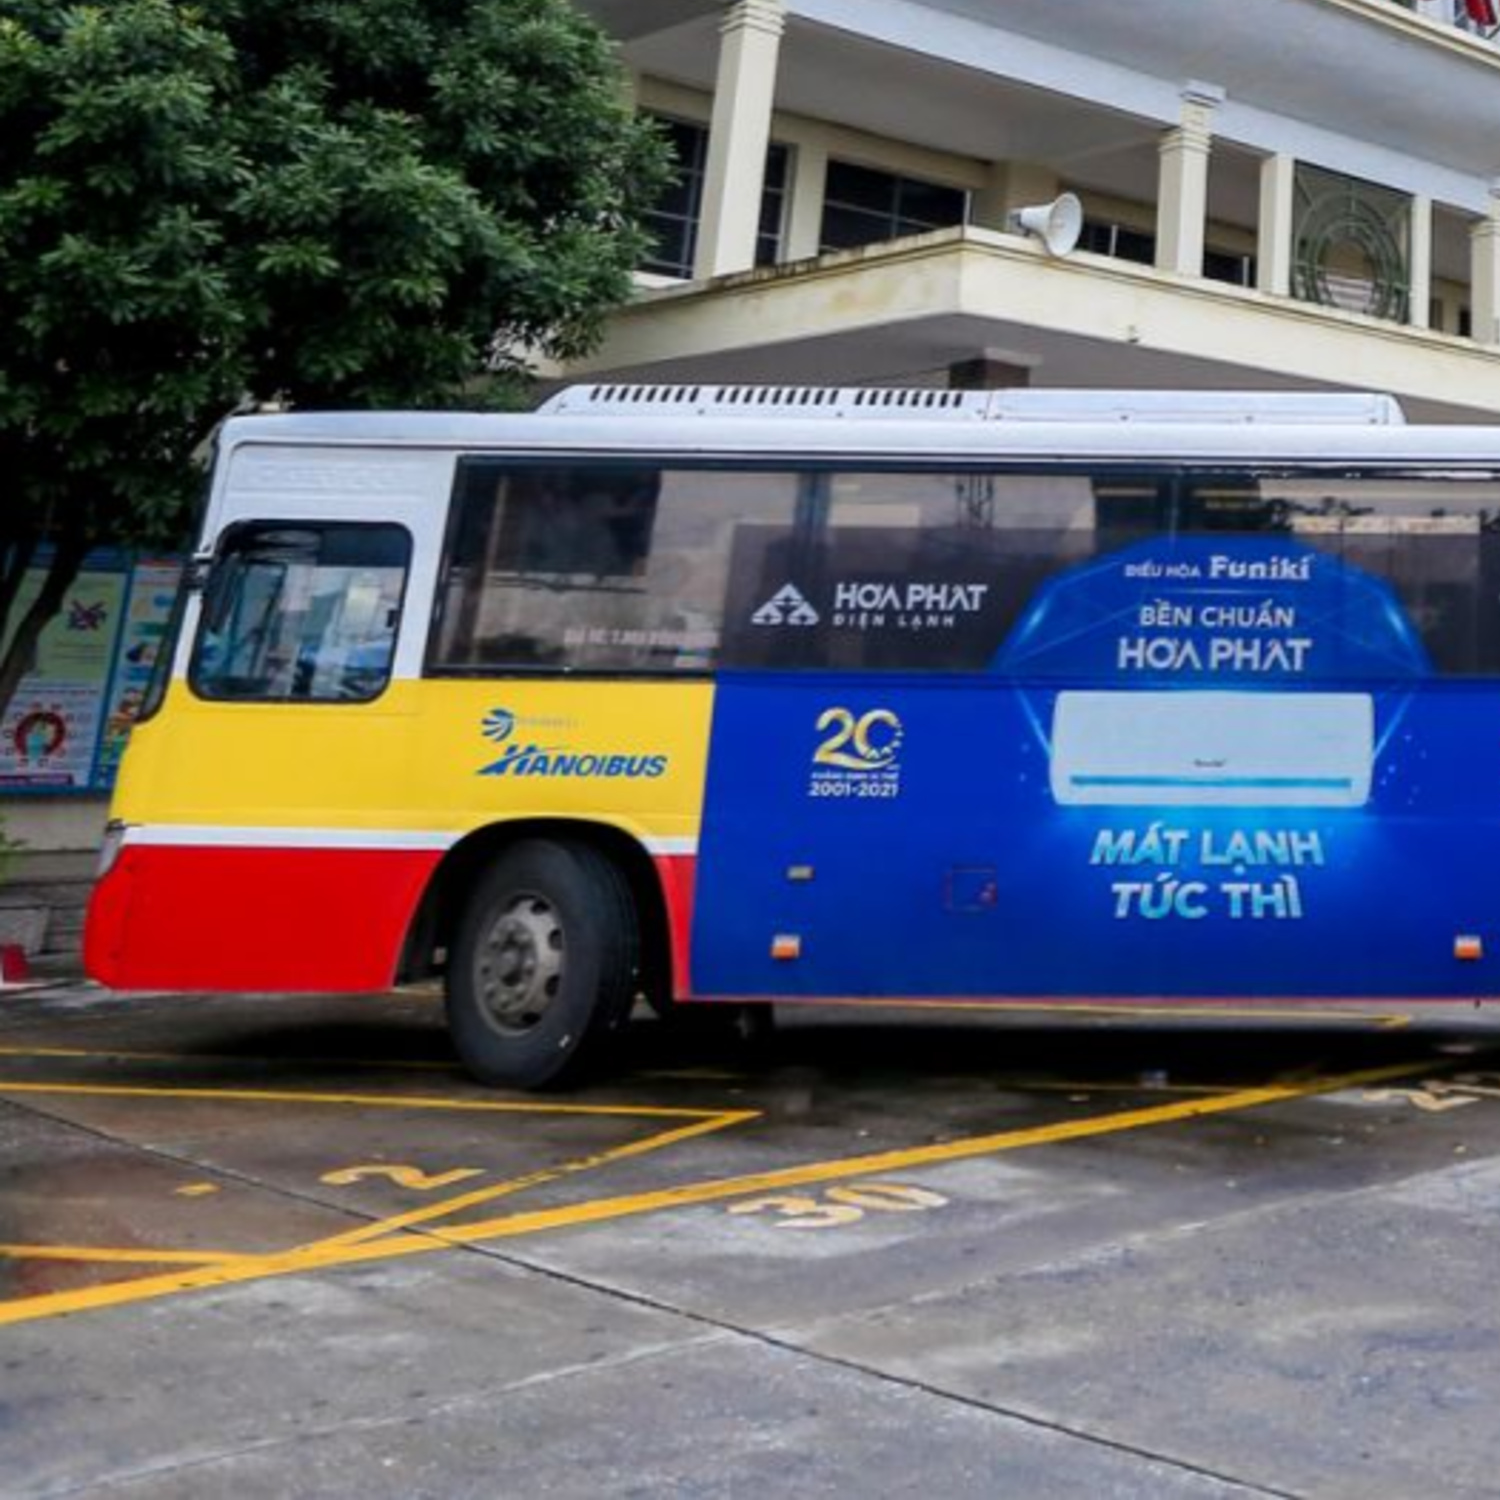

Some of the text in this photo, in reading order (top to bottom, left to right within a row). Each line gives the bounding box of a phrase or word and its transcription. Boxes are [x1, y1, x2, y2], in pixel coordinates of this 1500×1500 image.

[1209, 554, 1316, 580] Funiki
[833, 611, 956, 631] ĐIỆN LẠNH
[475, 744, 668, 777] HANOIBUS
[807, 780, 899, 797] 2001-2021
[1089, 820, 1325, 875] MÁT LẠNH
[1111, 872, 1303, 919] TỨC THÌ
[727, 1184, 948, 1227] 30
